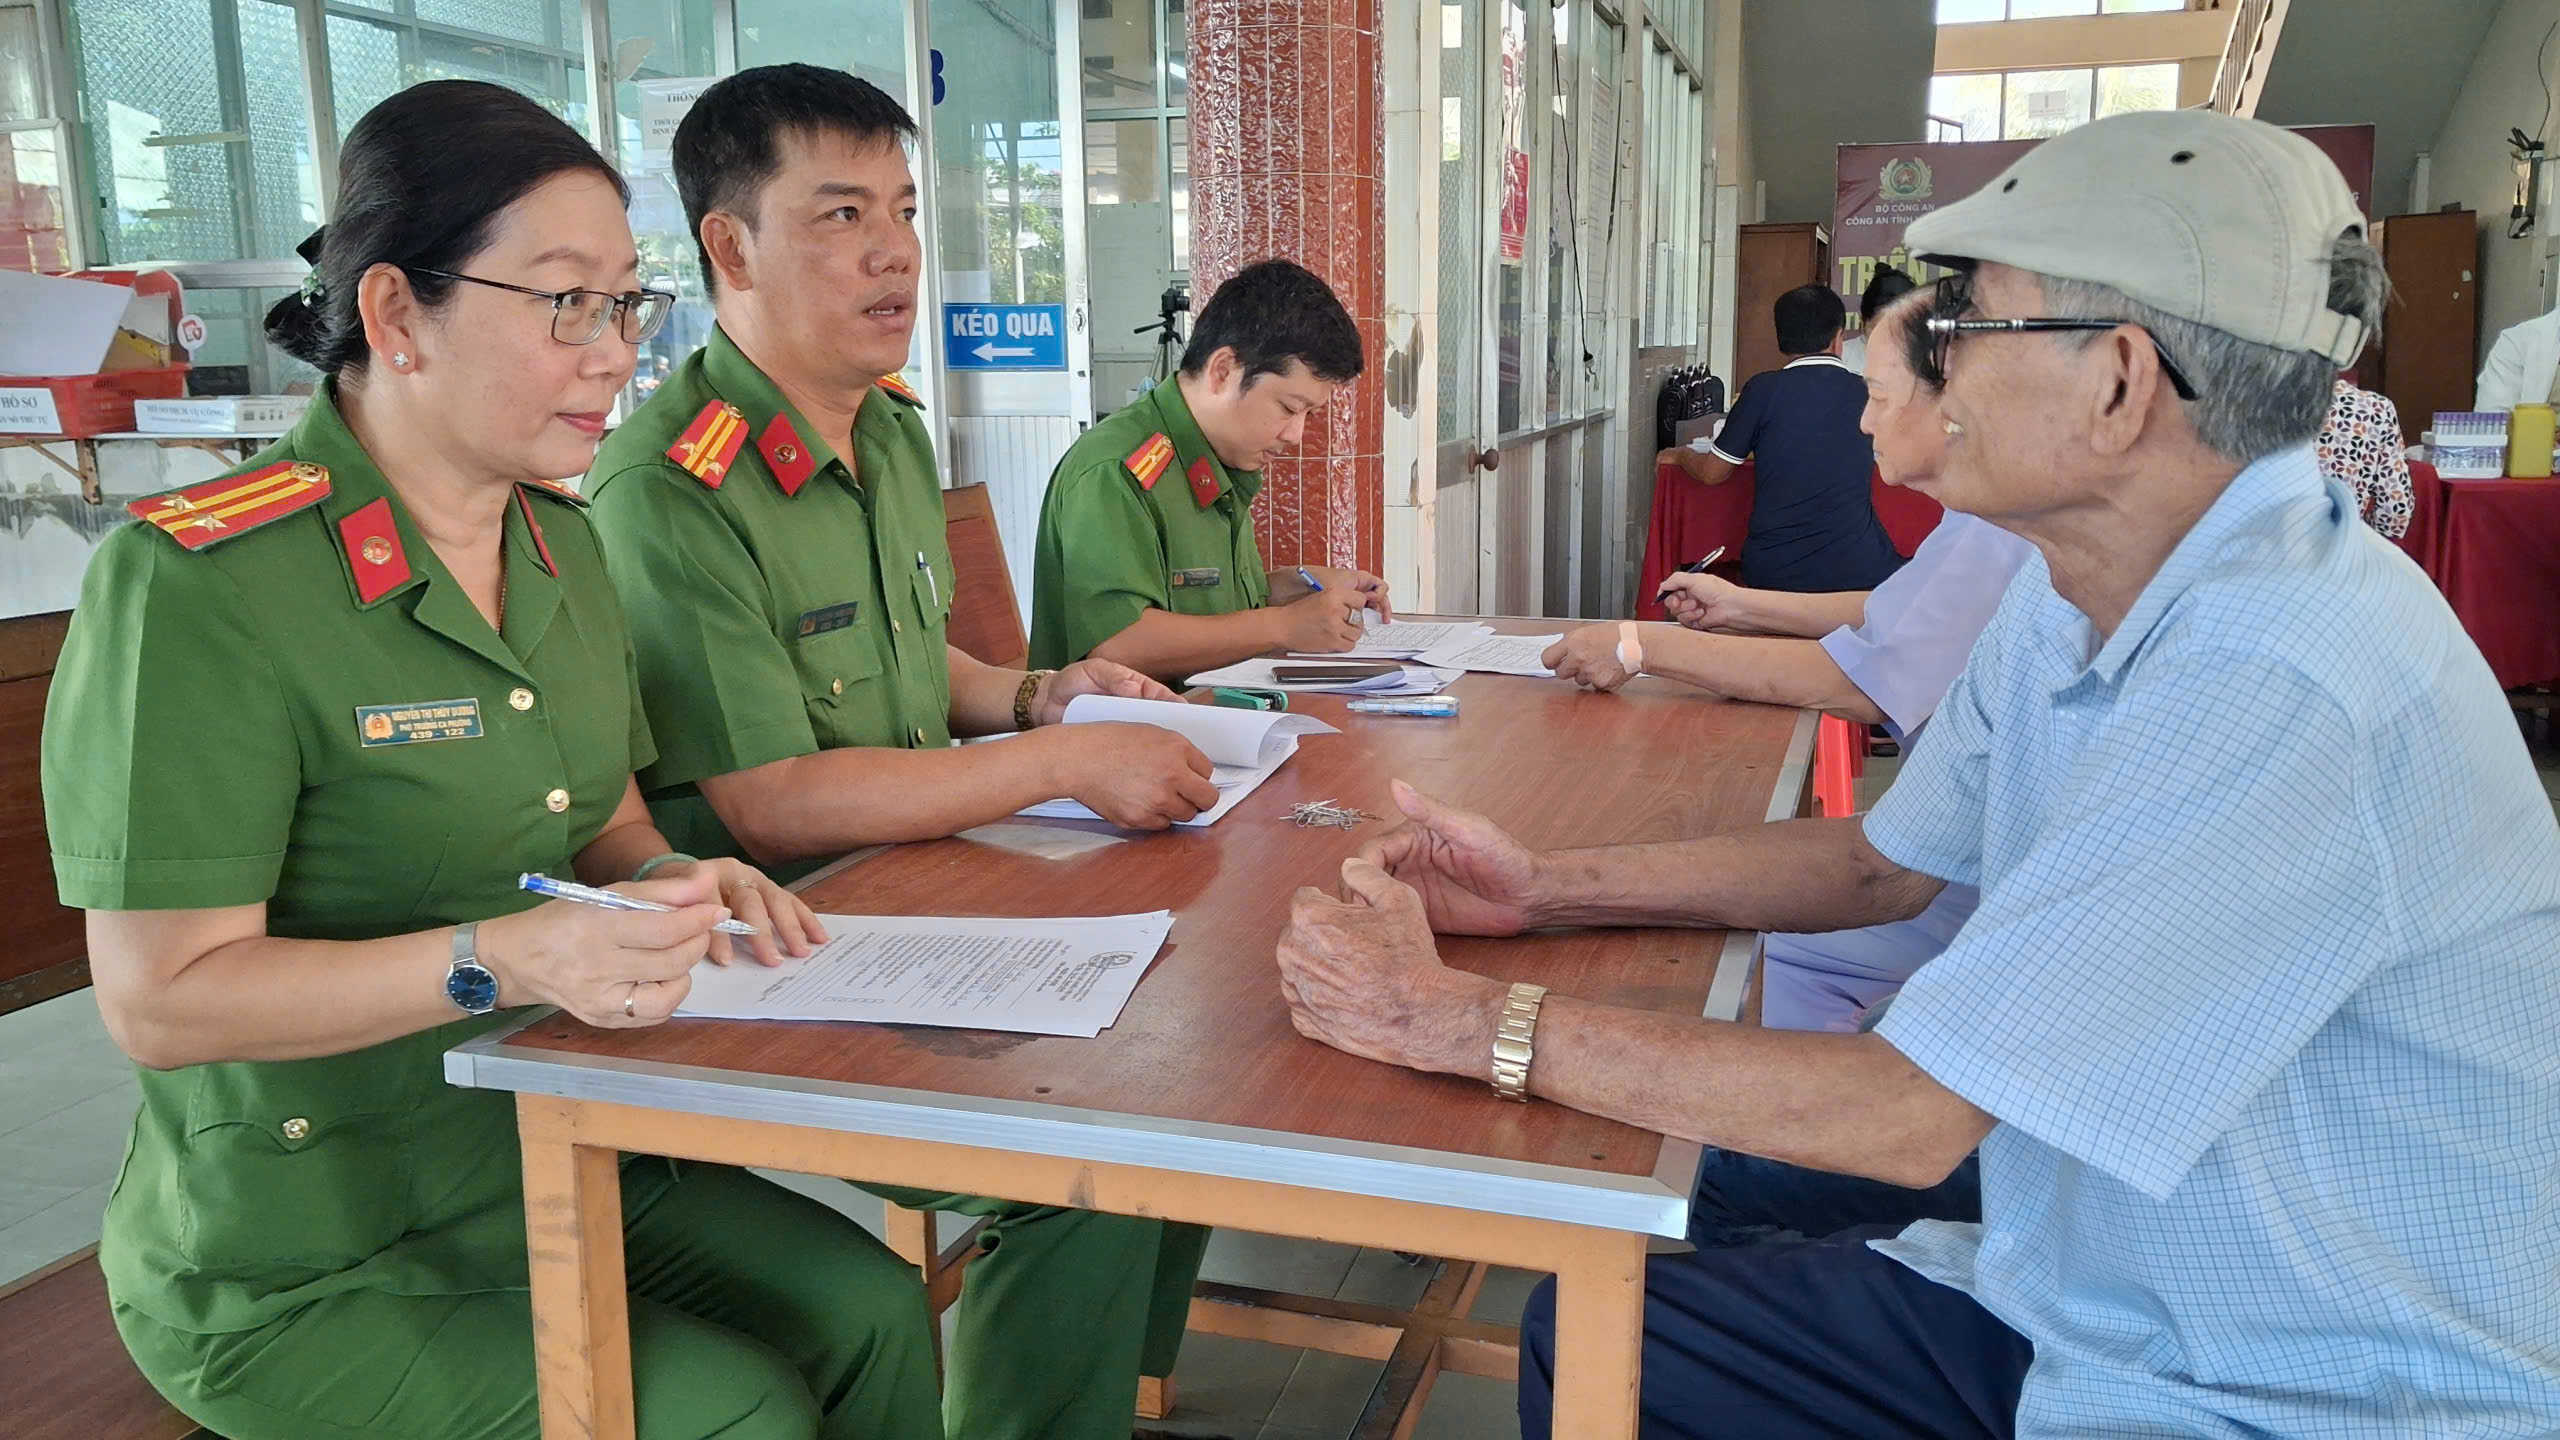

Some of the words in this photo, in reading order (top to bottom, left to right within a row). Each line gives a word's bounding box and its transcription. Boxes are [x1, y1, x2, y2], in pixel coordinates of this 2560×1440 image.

[1875, 204, 1889, 214] BỘ
[1892, 202, 1920, 212] CÔNG
[1922, 203, 1936, 212] AN
[1845, 215, 1873, 226] CÔNG
[1875, 216, 1889, 225] AN
[952, 307, 999, 337] KÉO
[1006, 312, 1055, 337] QUA
[410, 731, 433, 739] 439
[444, 728, 465, 736] 122
